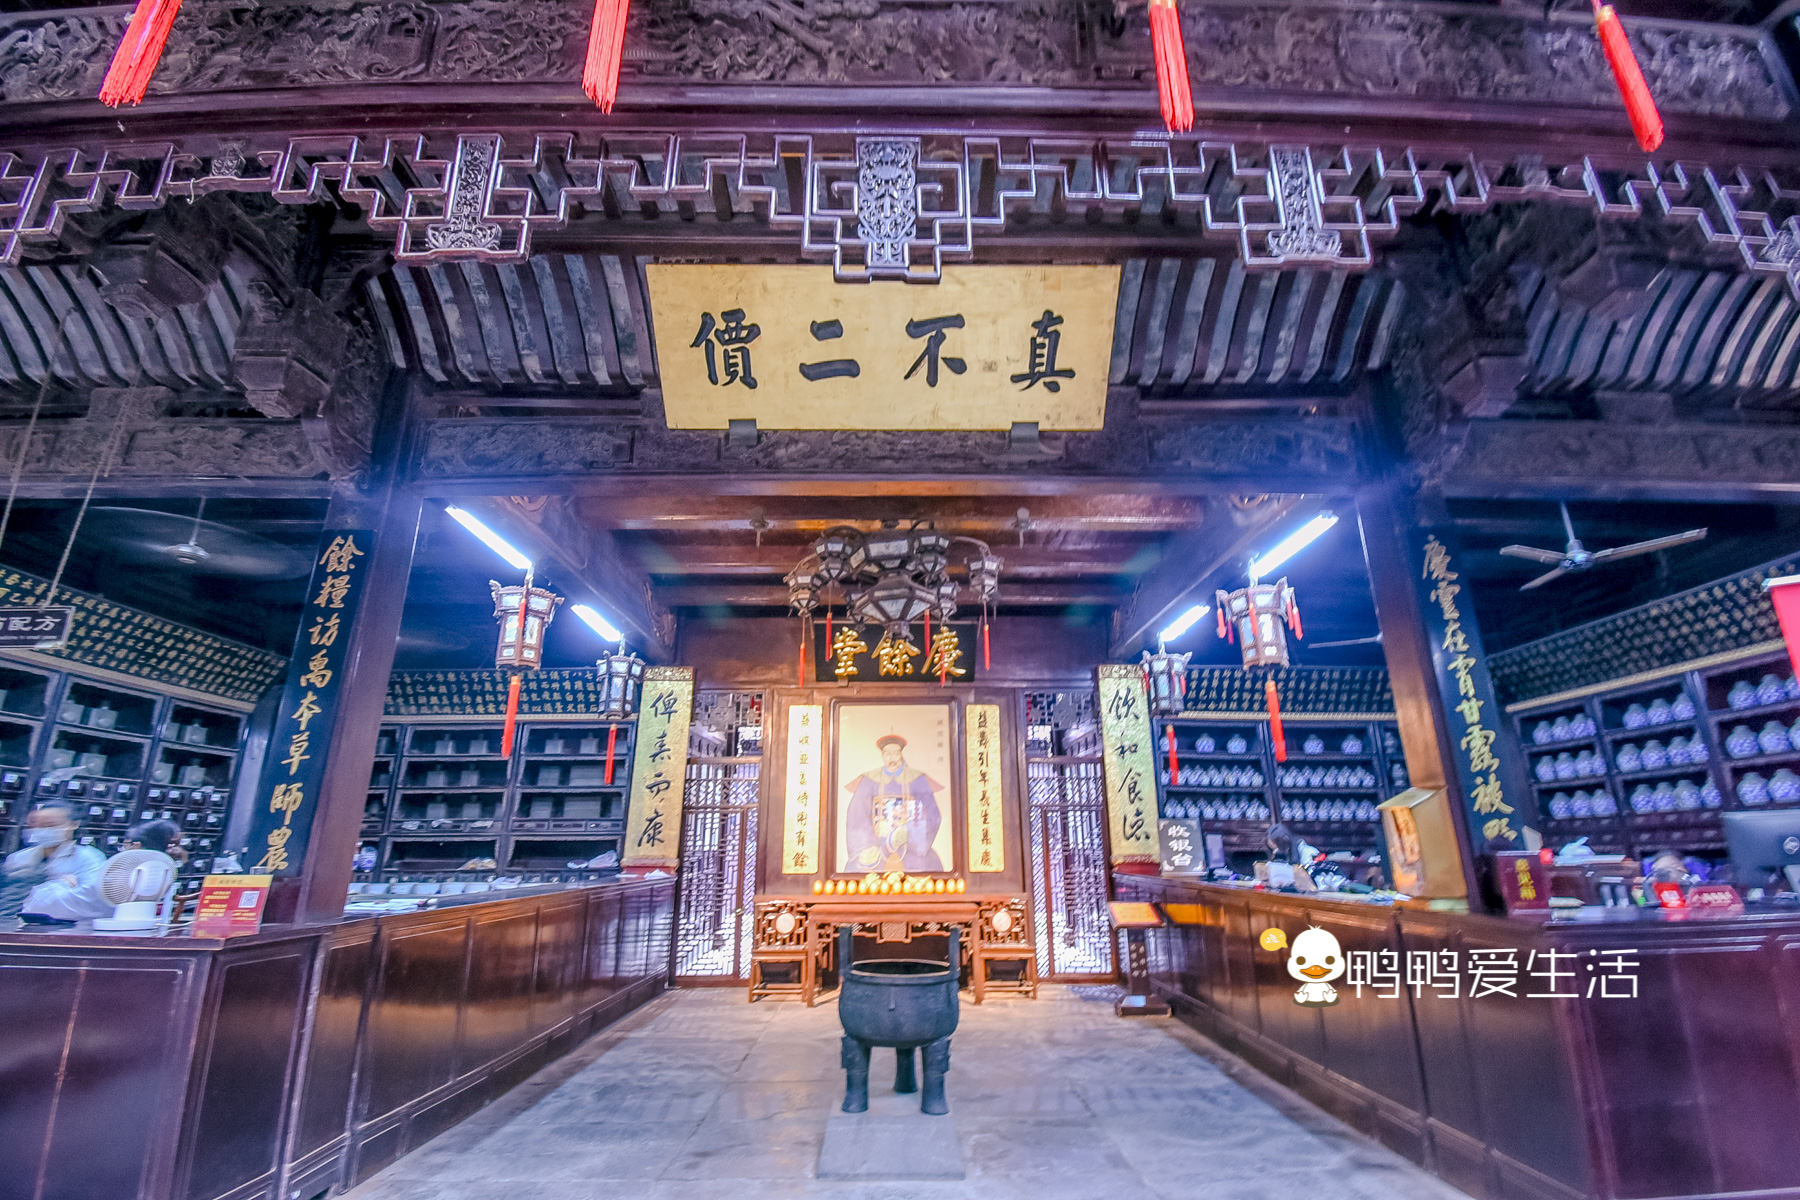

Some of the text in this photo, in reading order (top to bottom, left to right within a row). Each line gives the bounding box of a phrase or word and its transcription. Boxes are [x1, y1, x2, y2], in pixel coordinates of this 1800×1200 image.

[690, 308, 1076, 392] 真不二價
[0, 616, 62, 632] 配方
[833, 626, 967, 677] 慶餘堂
[1167, 825, 1194, 867] 收银台
